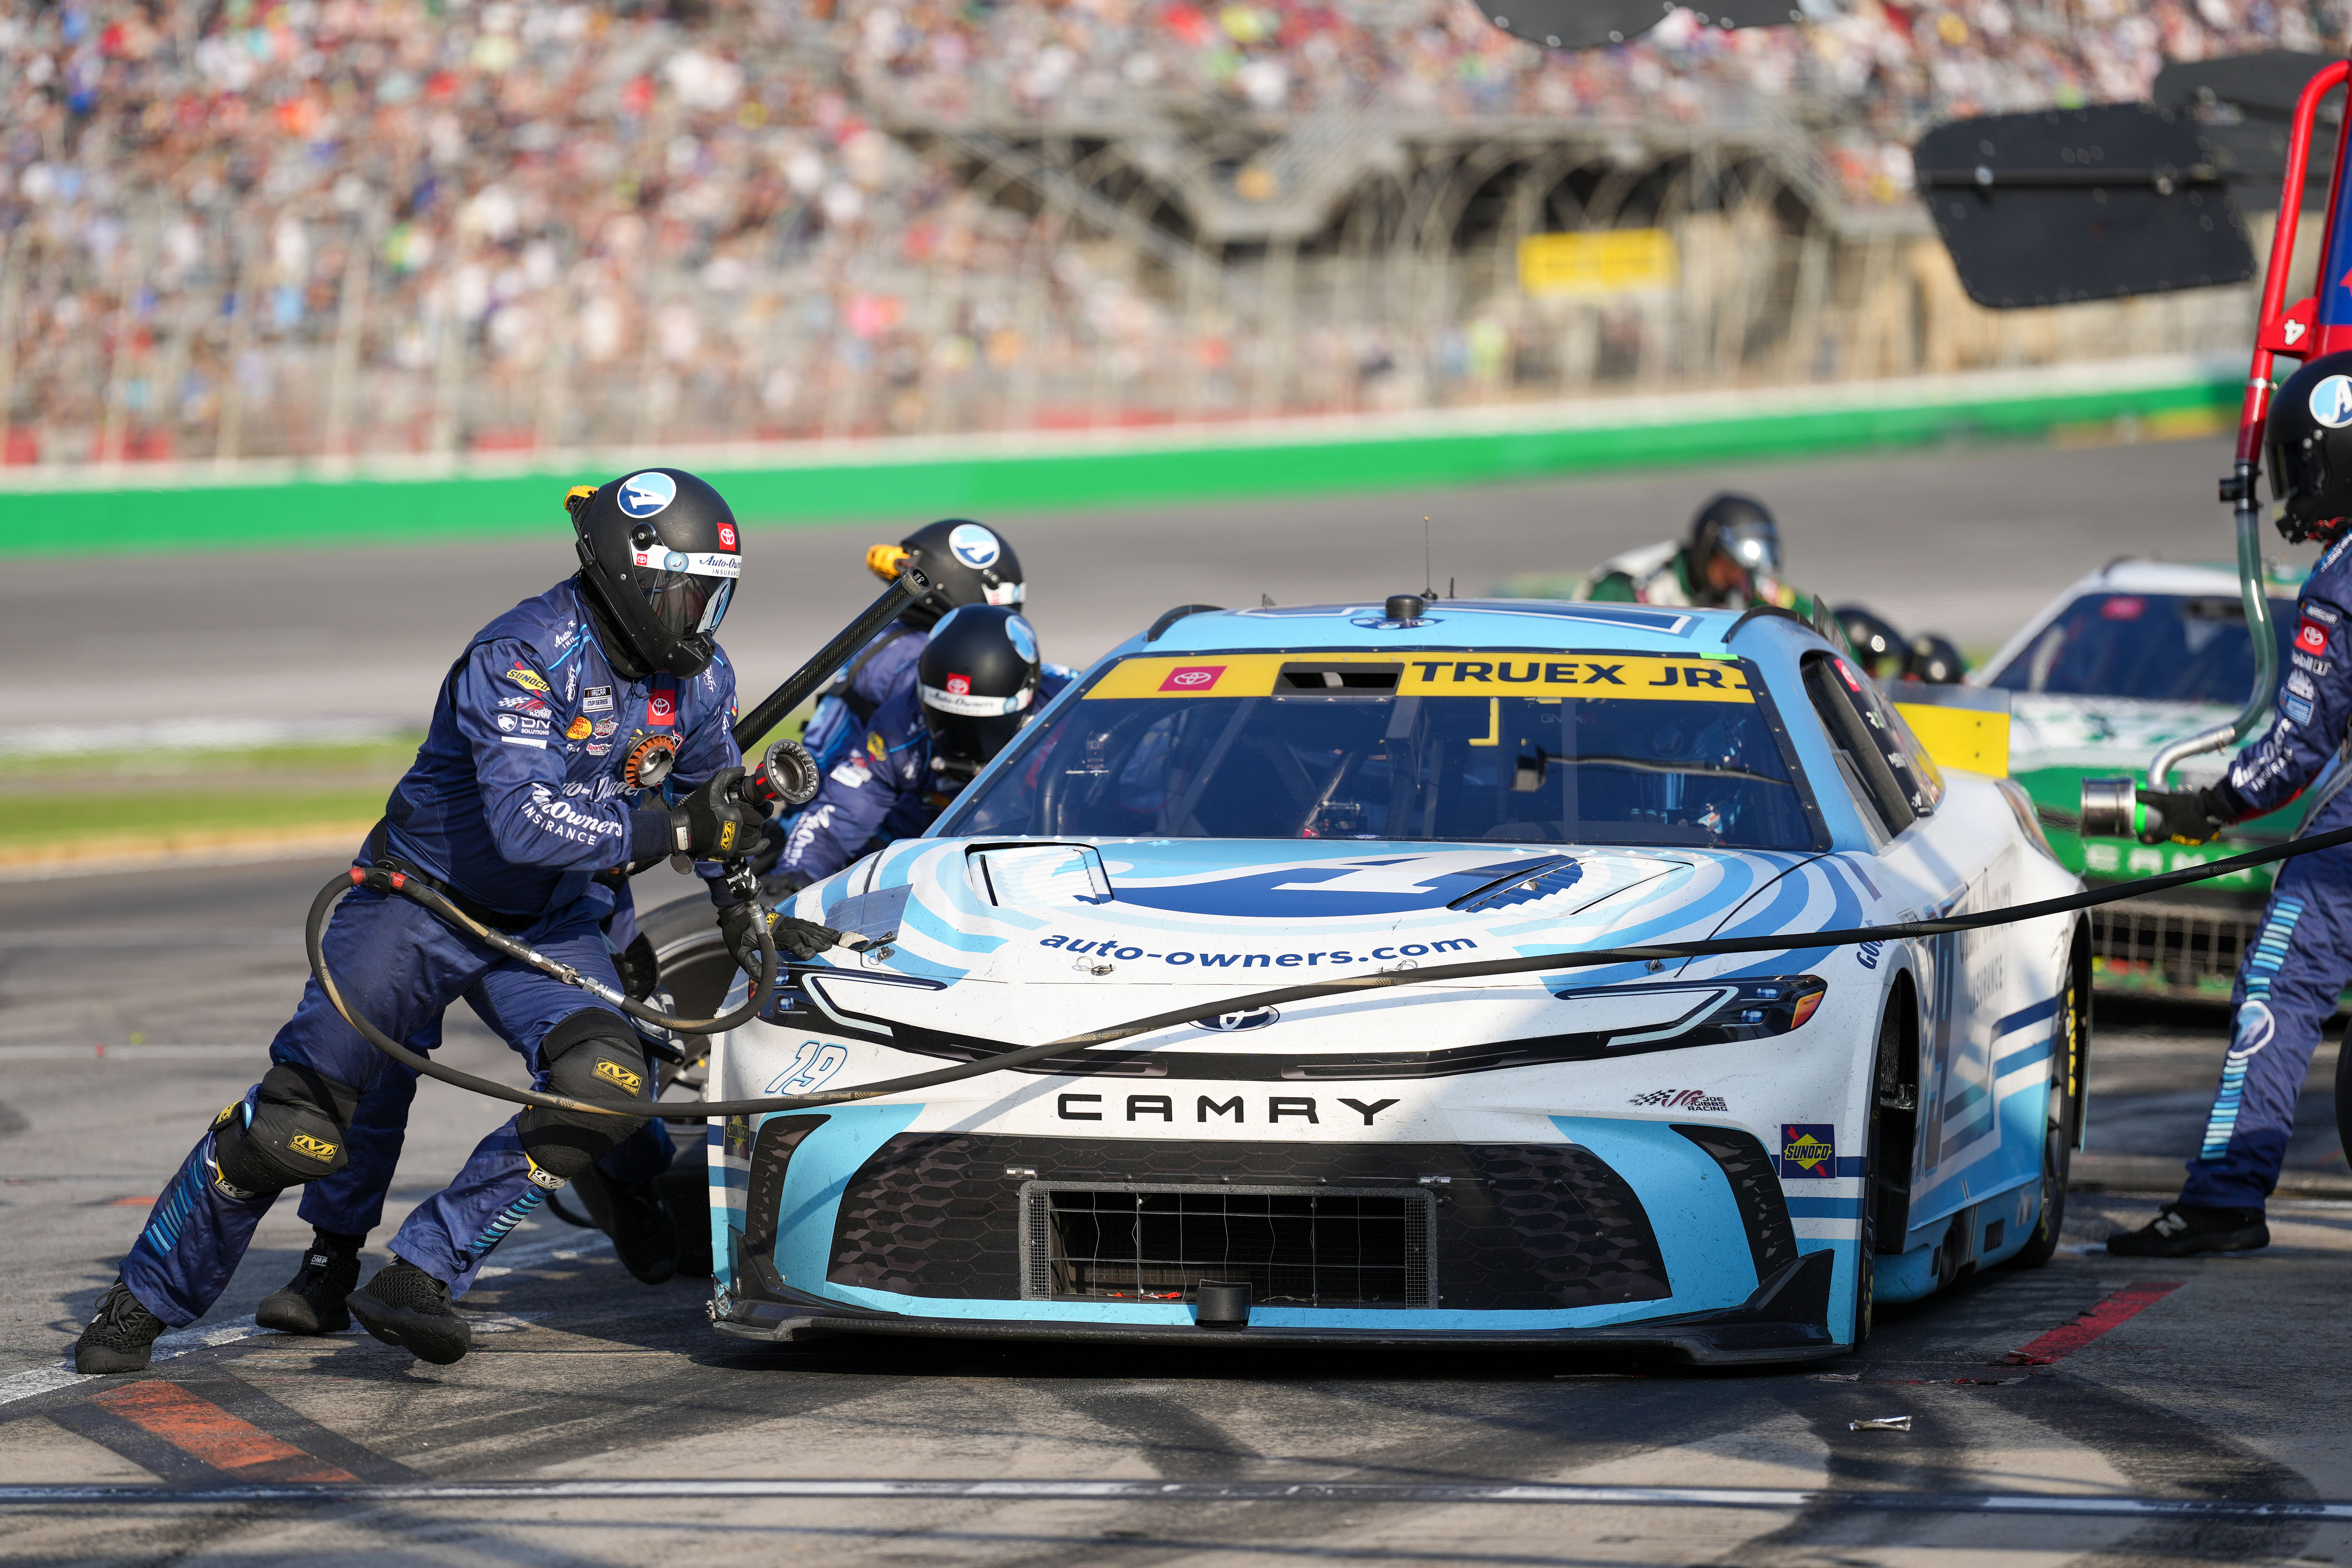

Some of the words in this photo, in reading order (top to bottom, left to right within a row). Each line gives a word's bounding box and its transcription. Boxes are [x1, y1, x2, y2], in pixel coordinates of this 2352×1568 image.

[712, 568, 739, 577] INSURANCE
[2307, 605, 2337, 625] NASCAR
[2292, 650, 2313, 672] obil
[509, 671, 549, 691] SUNOCO
[1412, 661, 1626, 685] TRUEX
[1649, 666, 1751, 690] JR.
[520, 716, 551, 729] DN
[570, 728, 589, 738] Shops
[521, 802, 596, 846] INSRANCE
[1039, 934, 1479, 968] auto-owners.com
[764, 1040, 848, 1095] 19
[595, 1069, 623, 1088] MECHANIX
[622, 1082, 638, 1094] WEAR
[1057, 1093, 1401, 1125] CAMRY
[728, 1123, 747, 1140] SUNOCO
[291, 1143, 317, 1158] MECHANIX
[1787, 1145, 1829, 1159] SUNOCO
[531, 1174, 551, 1187] MECHANIX
[311, 1256, 327, 1265] OMP
